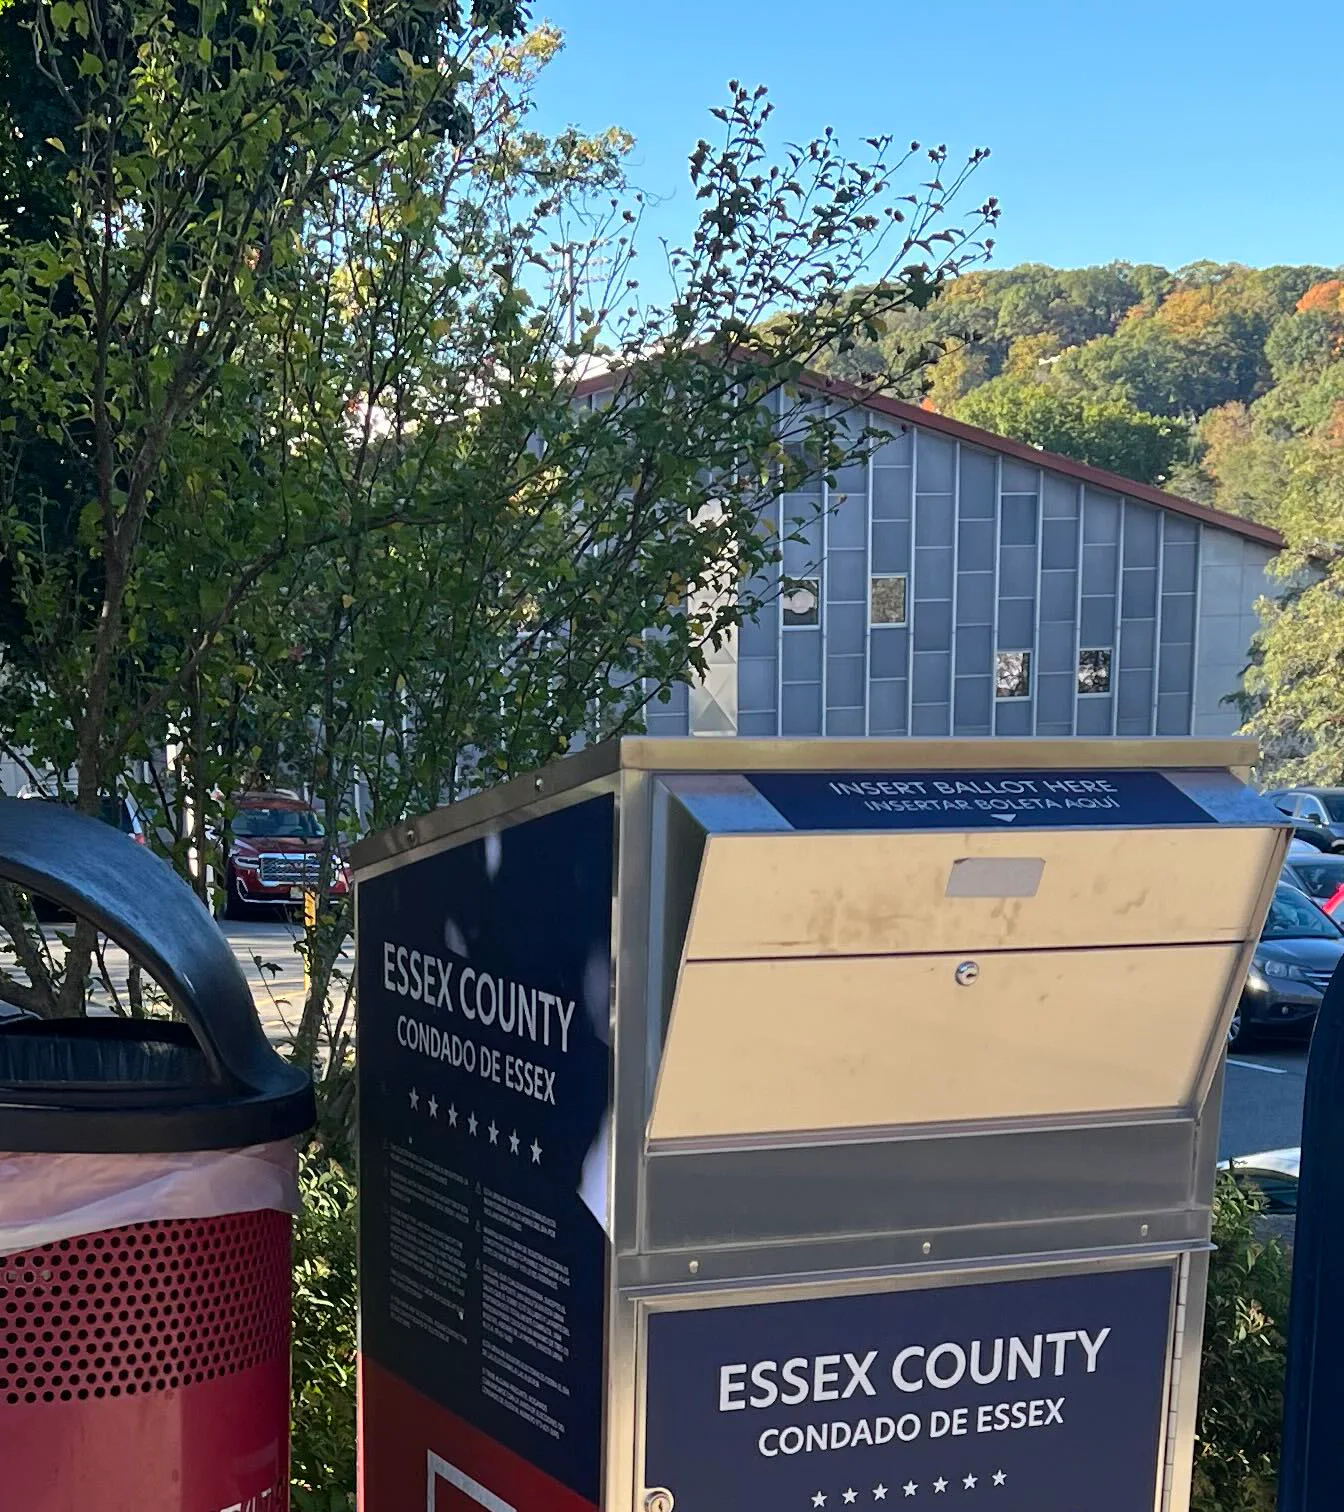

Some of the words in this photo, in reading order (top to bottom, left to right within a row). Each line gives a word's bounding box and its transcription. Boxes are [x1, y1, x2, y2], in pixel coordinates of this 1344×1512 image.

[828, 780, 930, 796] INSERT
[932, 780, 1044, 795] BALLOT
[1045, 779, 1119, 794] HERE
[863, 799, 969, 812] INSERTAR
[973, 798, 1062, 811] BOLETA
[383, 941, 454, 1012] ESSEX
[459, 966, 575, 1053] COUNTY
[397, 1015, 476, 1073] CONDADO
[480, 1045, 501, 1083] DE
[505, 1054, 556, 1106] ESSEX
[719, 1350, 880, 1412] ESSEX
[890, 1327, 1113, 1393] COUNTY
[758, 1412, 922, 1458] CONDADO
[929, 1408, 969, 1438] DE
[976, 1396, 1066, 1435] ESSEX
